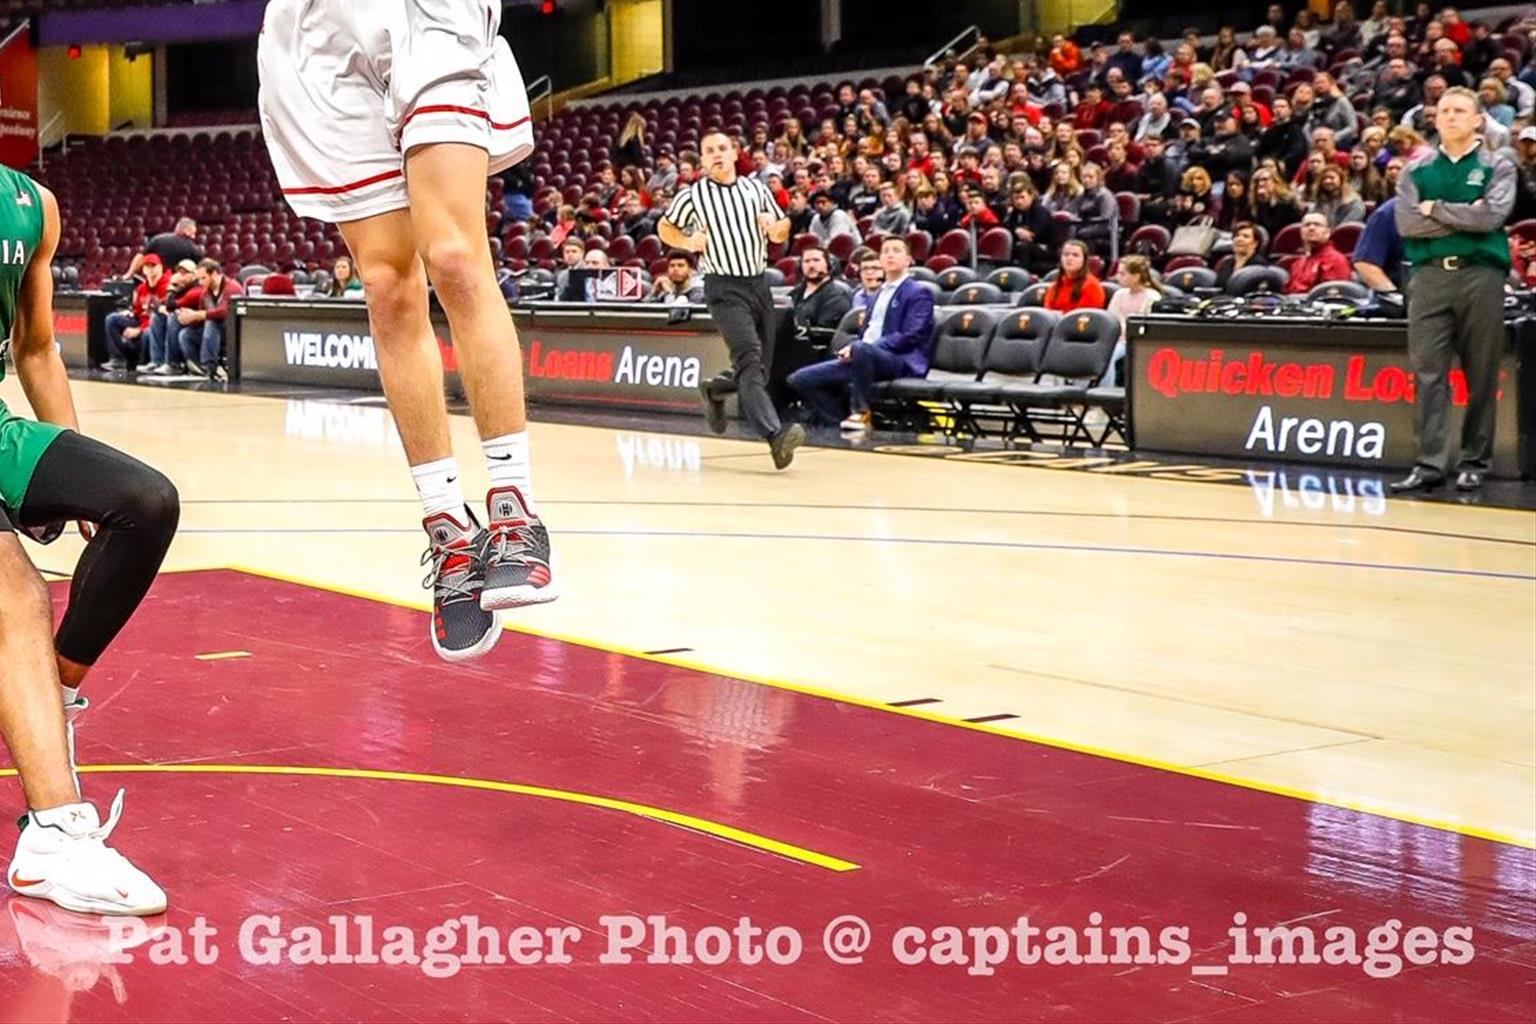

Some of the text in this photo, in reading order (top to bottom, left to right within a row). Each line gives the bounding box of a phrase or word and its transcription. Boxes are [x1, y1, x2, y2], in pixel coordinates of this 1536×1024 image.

[283, 331, 377, 370] WELCOM
[529, 341, 615, 383] Loans
[614, 346, 701, 389] Arena
[1147, 347, 1335, 398] Quicken
[1245, 405, 1386, 460] Arena
